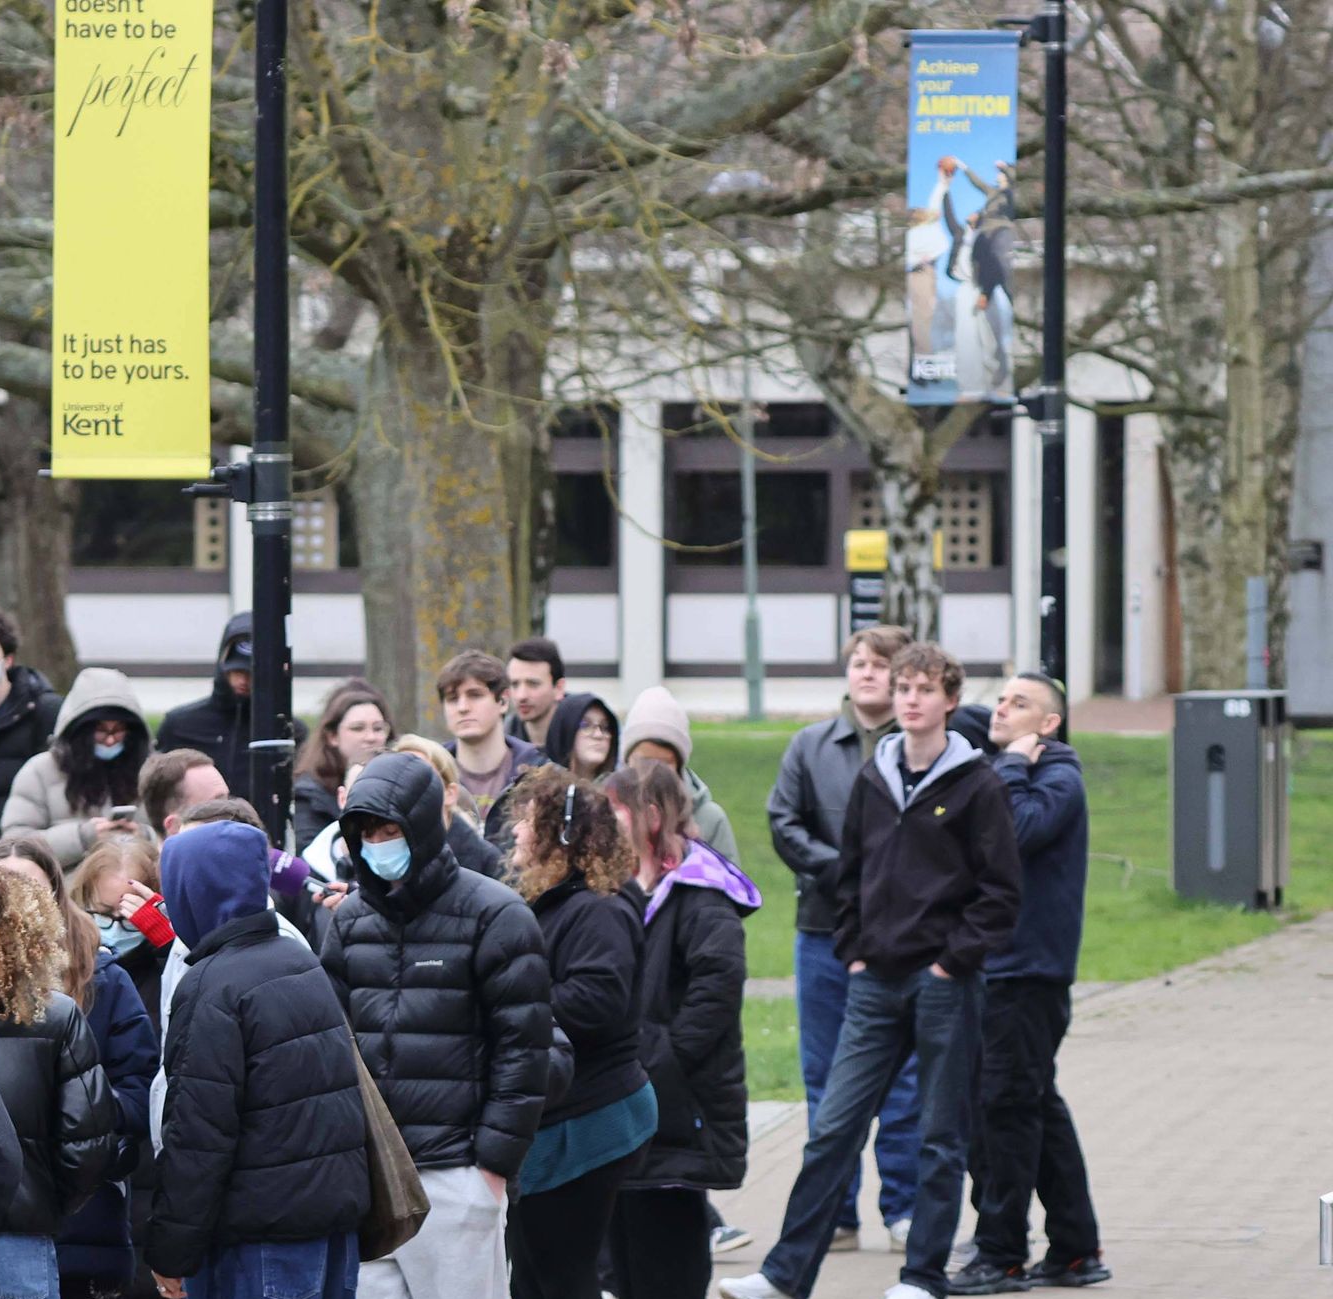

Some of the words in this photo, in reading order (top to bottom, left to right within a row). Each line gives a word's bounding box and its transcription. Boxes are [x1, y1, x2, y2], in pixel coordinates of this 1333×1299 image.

[65, 0, 144, 12] doesnt
[65, 19, 118, 38] have
[123, 19, 145, 38] to
[151, 19, 177, 38] be
[917, 59, 979, 75] Achieve
[65, 46, 199, 137] perfect
[917, 80, 953, 94] your
[916, 95, 1010, 116] AMBITION
[916, 119, 931, 133] at
[935, 118, 971, 133] Kent
[63, 334, 77, 354] It
[81, 333, 124, 359] just
[130, 334, 167, 354] has
[62, 360, 84, 379] to
[91, 360, 117, 379] be
[123, 364, 190, 384] yours.
[63, 402, 111, 414] University
[113, 402, 124, 411] of
[63, 413, 124, 436] Kent
